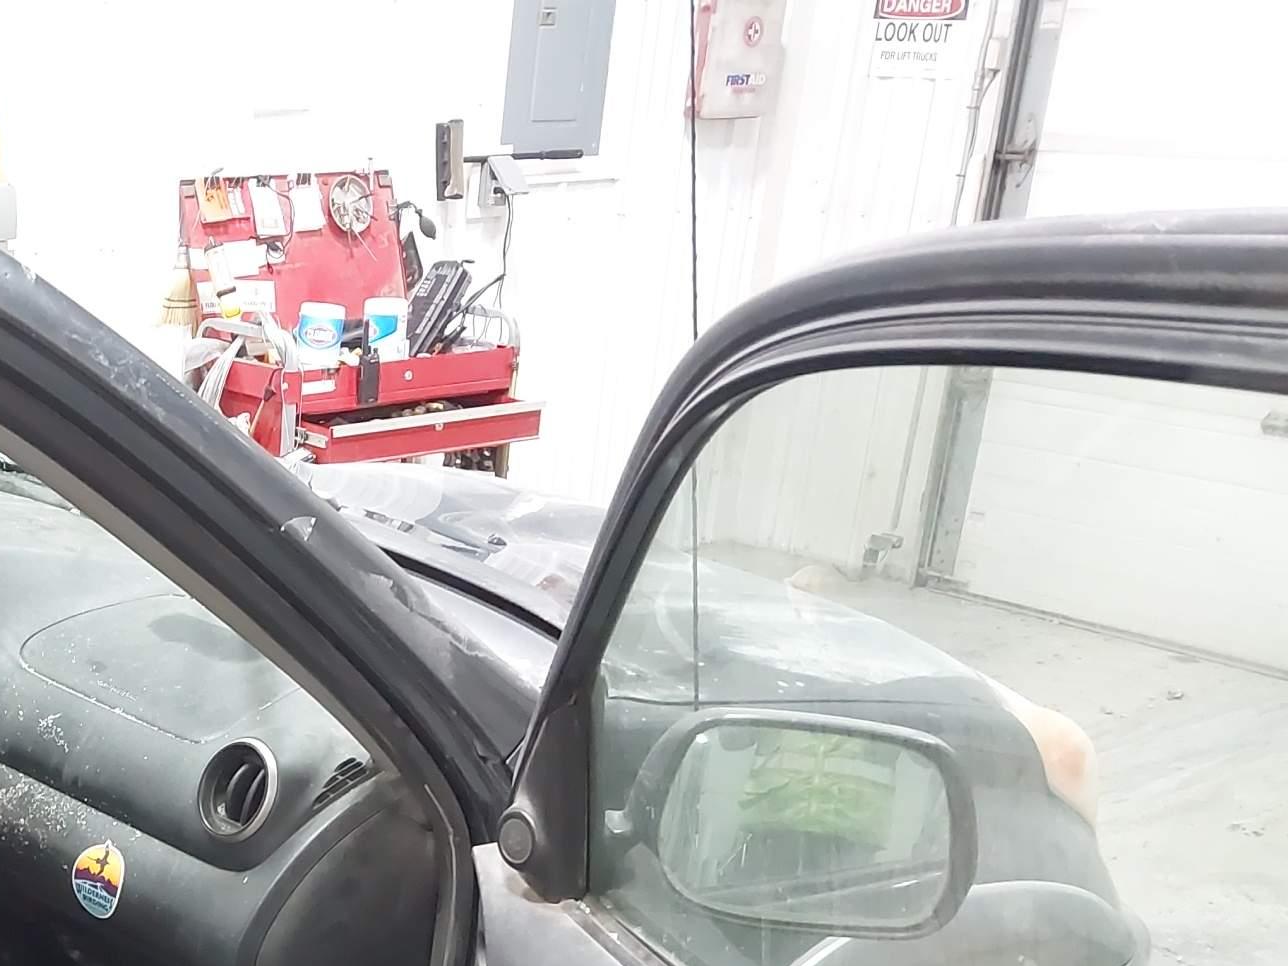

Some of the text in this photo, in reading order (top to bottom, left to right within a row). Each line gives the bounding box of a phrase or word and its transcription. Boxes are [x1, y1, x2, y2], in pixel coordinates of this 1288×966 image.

[882, 0, 952, 14] DANGER
[875, 22, 952, 42] LOOK OUT
[880, 50, 896, 60] FOR
[897, 51, 912, 61] LIFT
